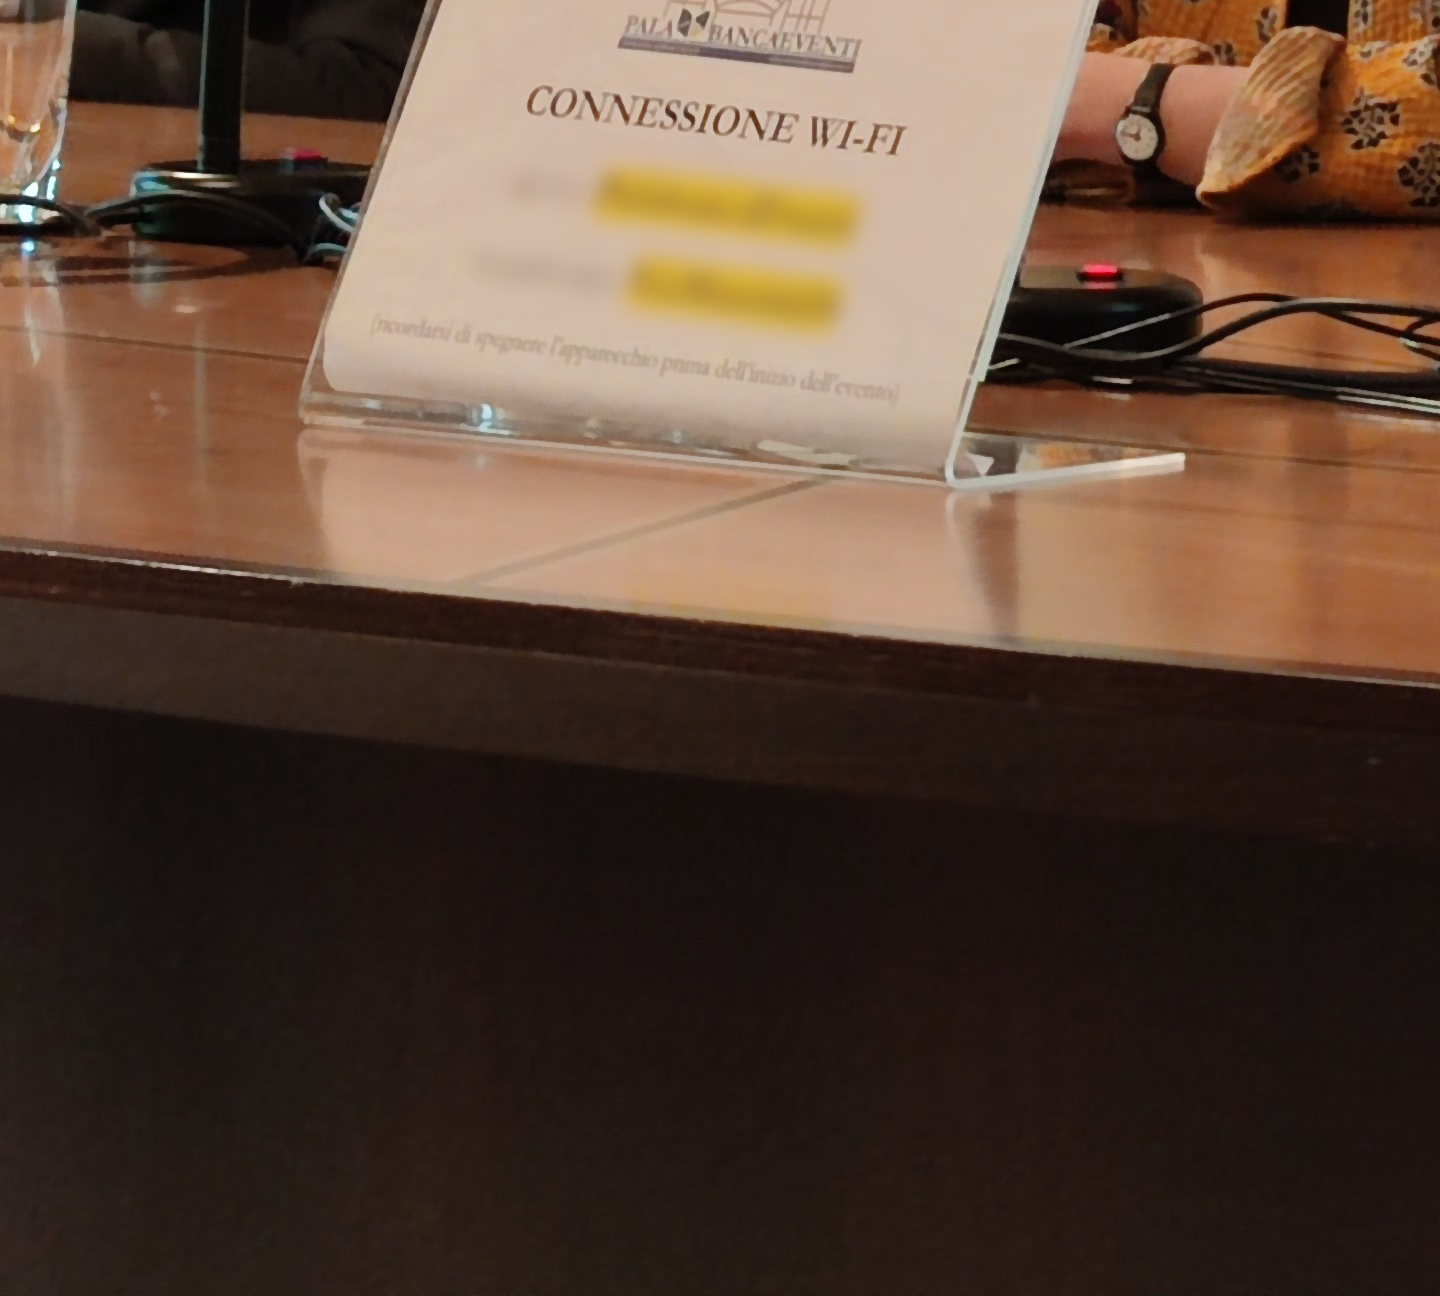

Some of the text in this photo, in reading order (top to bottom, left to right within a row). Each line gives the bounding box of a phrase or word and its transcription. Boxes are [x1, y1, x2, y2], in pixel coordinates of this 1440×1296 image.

[525, 83, 908, 157] CONNESSIONE WI-FI
[454, 322, 473, 345] di
